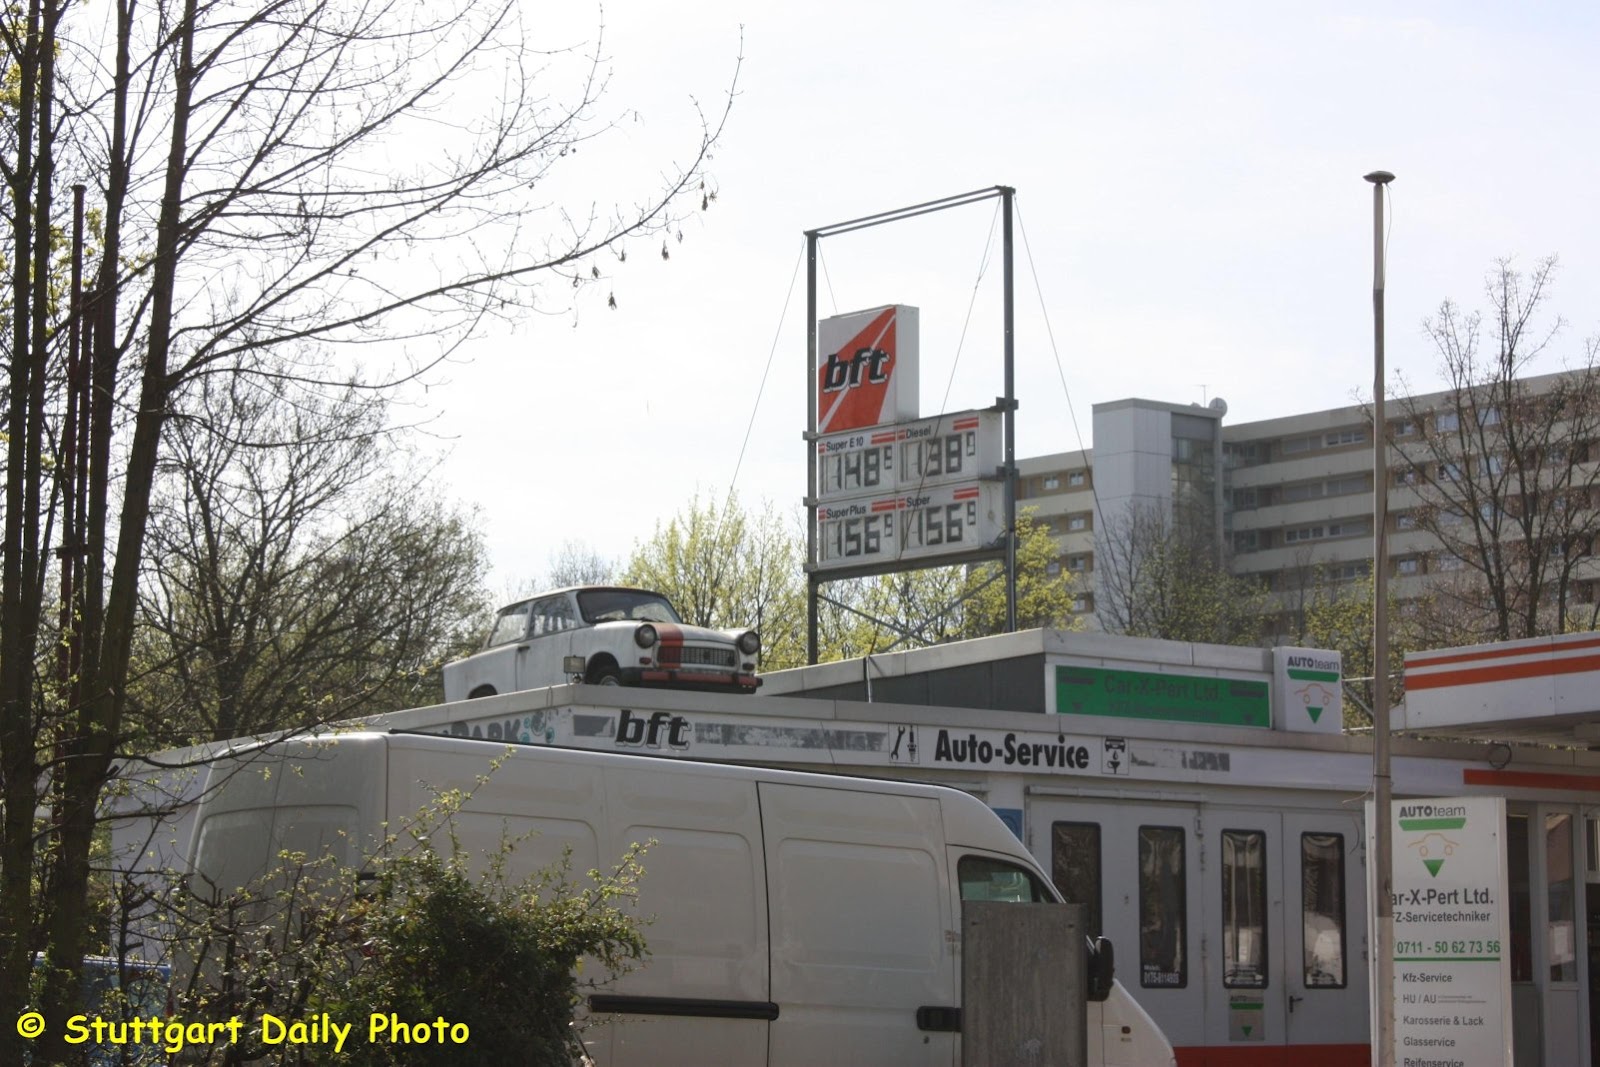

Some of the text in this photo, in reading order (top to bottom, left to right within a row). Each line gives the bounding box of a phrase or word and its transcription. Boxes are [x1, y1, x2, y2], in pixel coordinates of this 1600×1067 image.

[823, 347, 890, 393] bft
[905, 425, 932, 439] Diesel
[826, 436, 864, 452] Super E 10
[906, 496, 931, 508] Super
[1287, 656, 1340, 671] AUTOteam
[615, 709, 692, 750] bft
[934, 729, 1089, 769] Auto-Service
[1399, 805, 1466, 818] AUTOteam
[1392, 887, 1494, 906] ar-X-Pert Ltd.
[1397, 941, 1422, 953] 0711
[1435, 941, 1448, 953] 50
[1452, 941, 1465, 953] 62
[1469, 941, 1483, 953] 73
[1487, 940, 1500, 953] 56
[1402, 973, 1453, 983] Kfz-Service
[1402, 994, 1416, 1004] HU
[1423, 994, 1437, 1004] AU
[1403, 1015, 1484, 1026] Karosserie & Lack
[1403, 1036, 1456, 1047] Glasservice
[1403, 1058, 1464, 1067] Reifenservice
